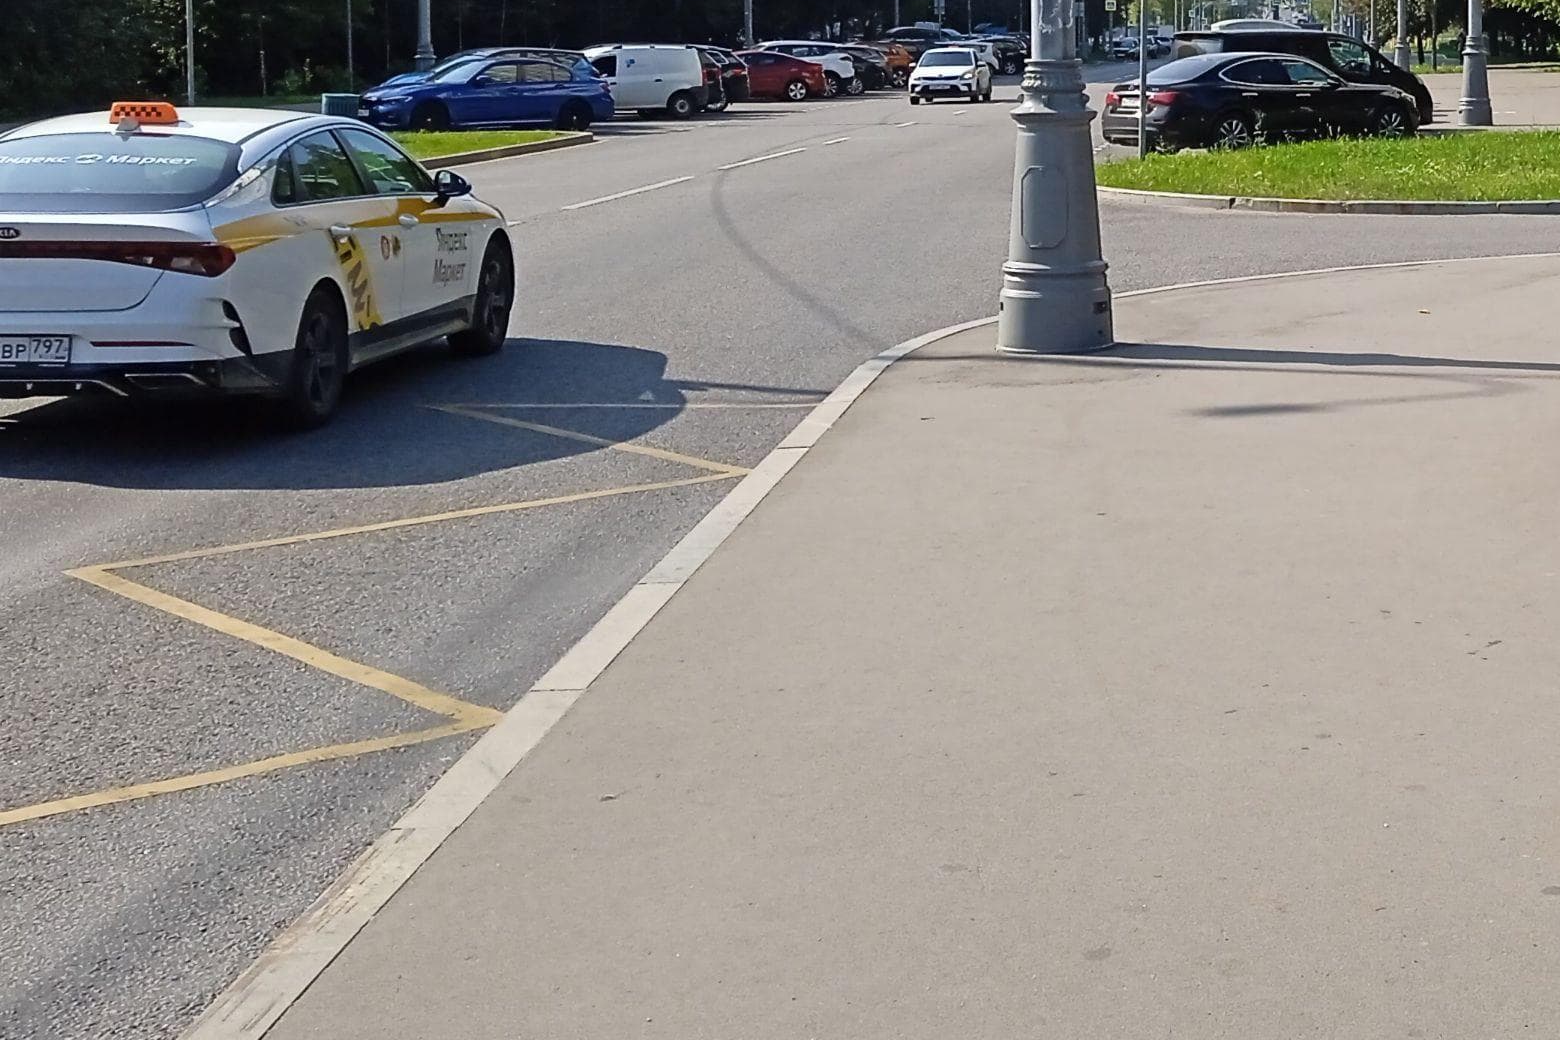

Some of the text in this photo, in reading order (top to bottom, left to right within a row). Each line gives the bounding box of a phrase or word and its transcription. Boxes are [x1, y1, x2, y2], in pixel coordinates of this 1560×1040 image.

[105, 155, 197, 165] Маркет
[436, 227, 467, 254] Яндекс
[432, 259, 466, 287] Маркет
[32, 339, 64, 354] 797
